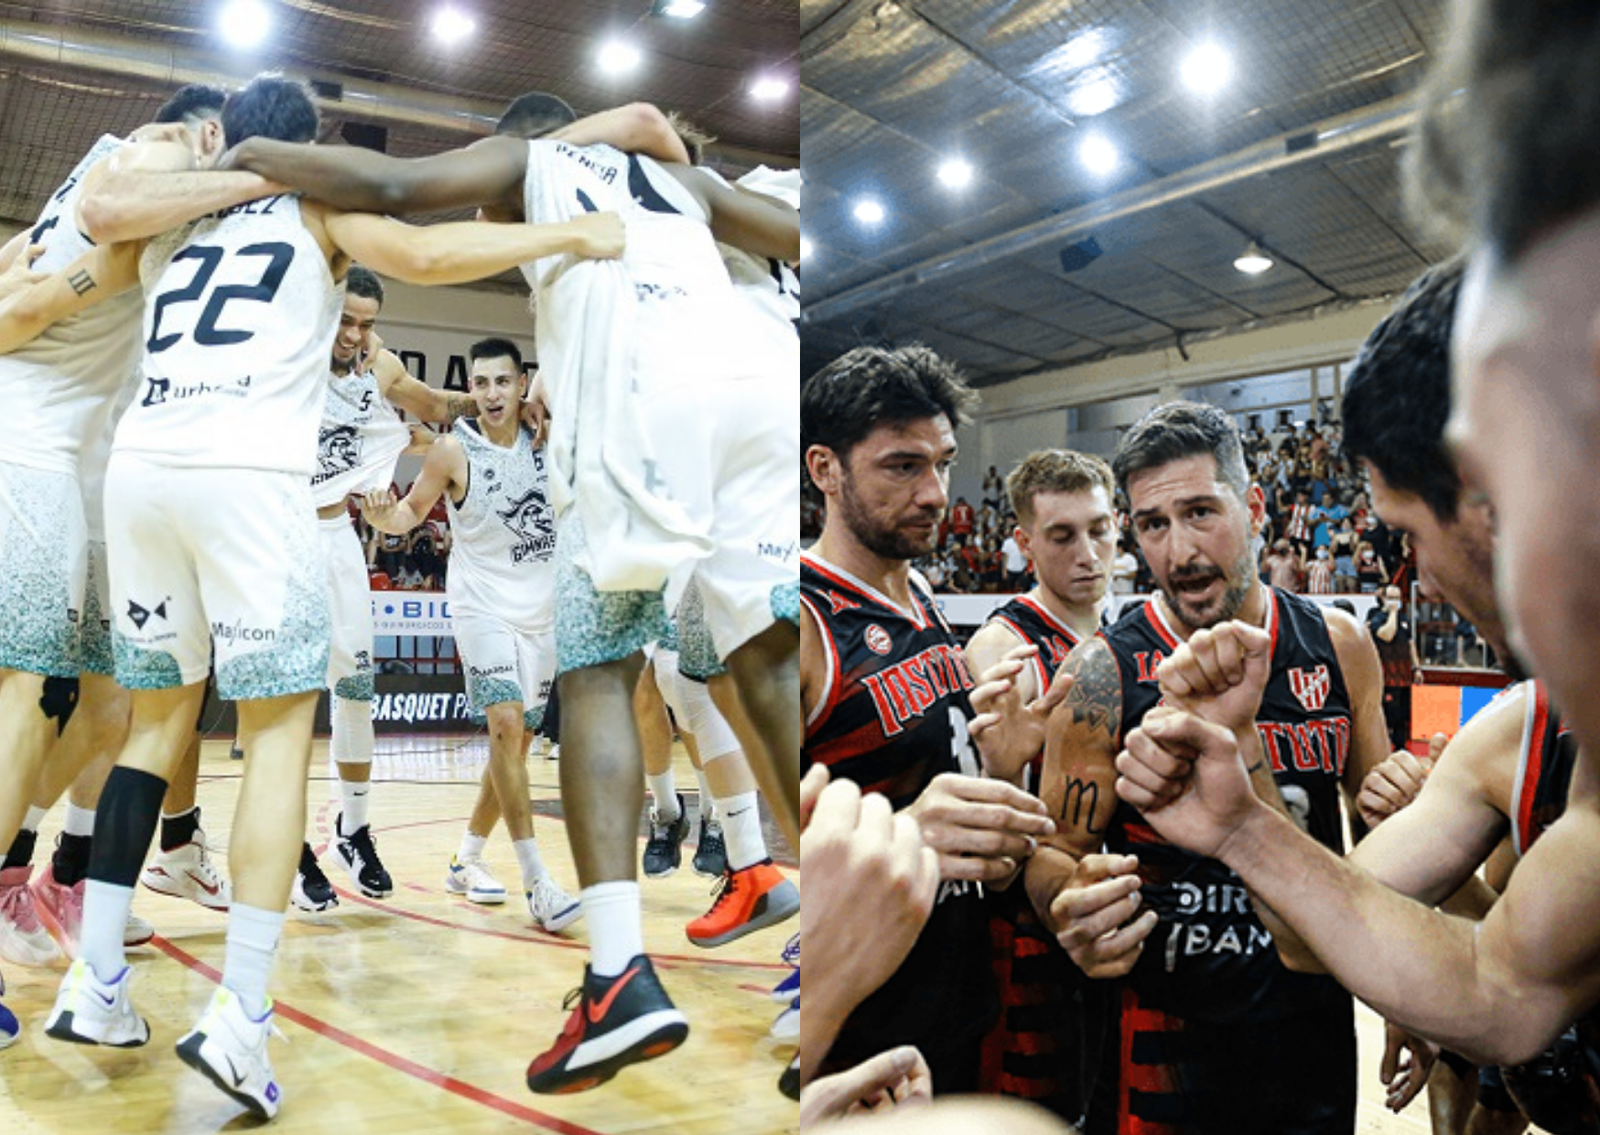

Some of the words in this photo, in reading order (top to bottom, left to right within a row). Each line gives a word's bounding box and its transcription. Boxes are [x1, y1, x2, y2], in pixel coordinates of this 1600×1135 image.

[146, 241, 295, 354] 22
[359, 390, 373, 412] 5
[371, 692, 452, 725] BASQUET
